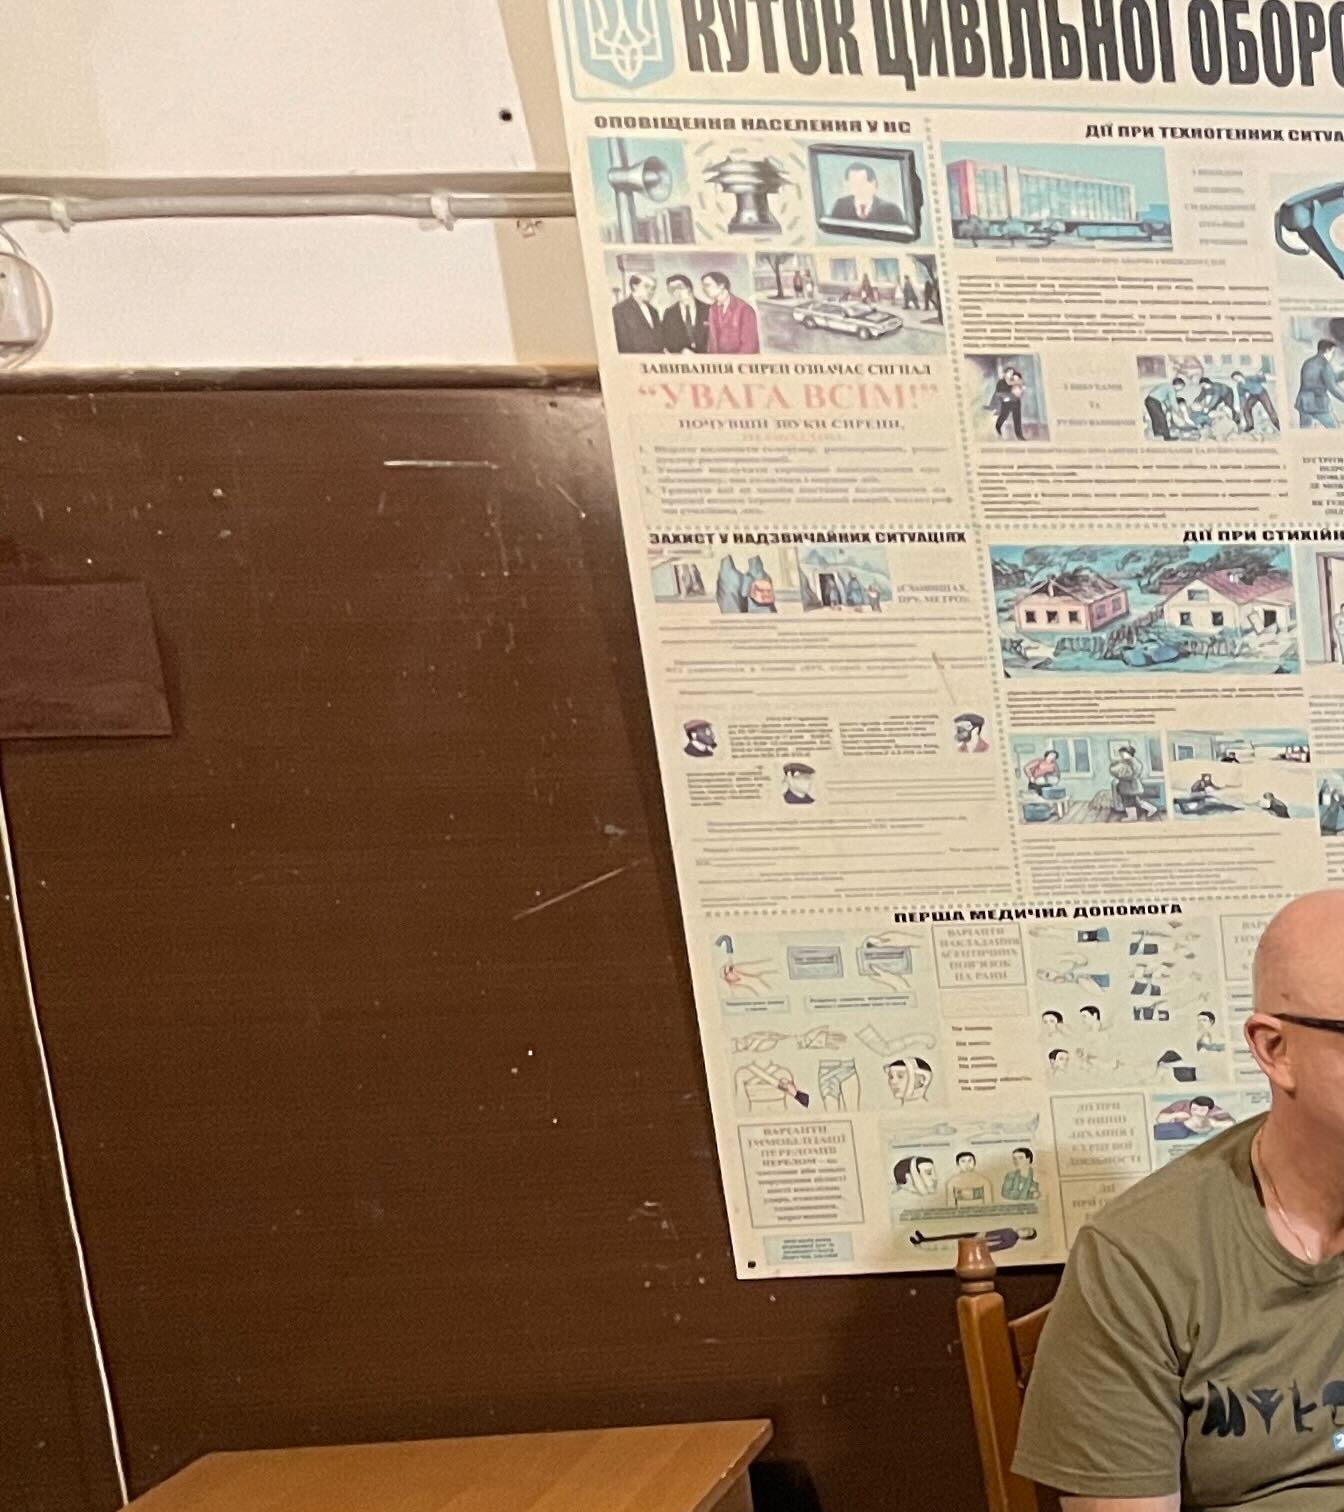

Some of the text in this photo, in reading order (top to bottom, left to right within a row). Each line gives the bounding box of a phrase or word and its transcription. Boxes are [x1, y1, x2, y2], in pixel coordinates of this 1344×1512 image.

[682, 0, 864, 76] КУТОК
[594, 115, 736, 131] ОПОВІЩЕННЯ
[741, 118, 862, 132] НАСЕЛЕННЯ
[1118, 126, 1155, 138] ПРИ
[1159, 126, 1284, 141] ТЕХНОГЕННИХ
[649, 532, 715, 546] ЗАХИСТ
[719, 533, 730, 545] У
[734, 530, 870, 546] НАДЗВИЧАЙНИХ
[1218, 530, 1257, 541] ПРИ
[894, 903, 1183, 923] ПЕРША МЕДИЧНА ДОПОМОГА
